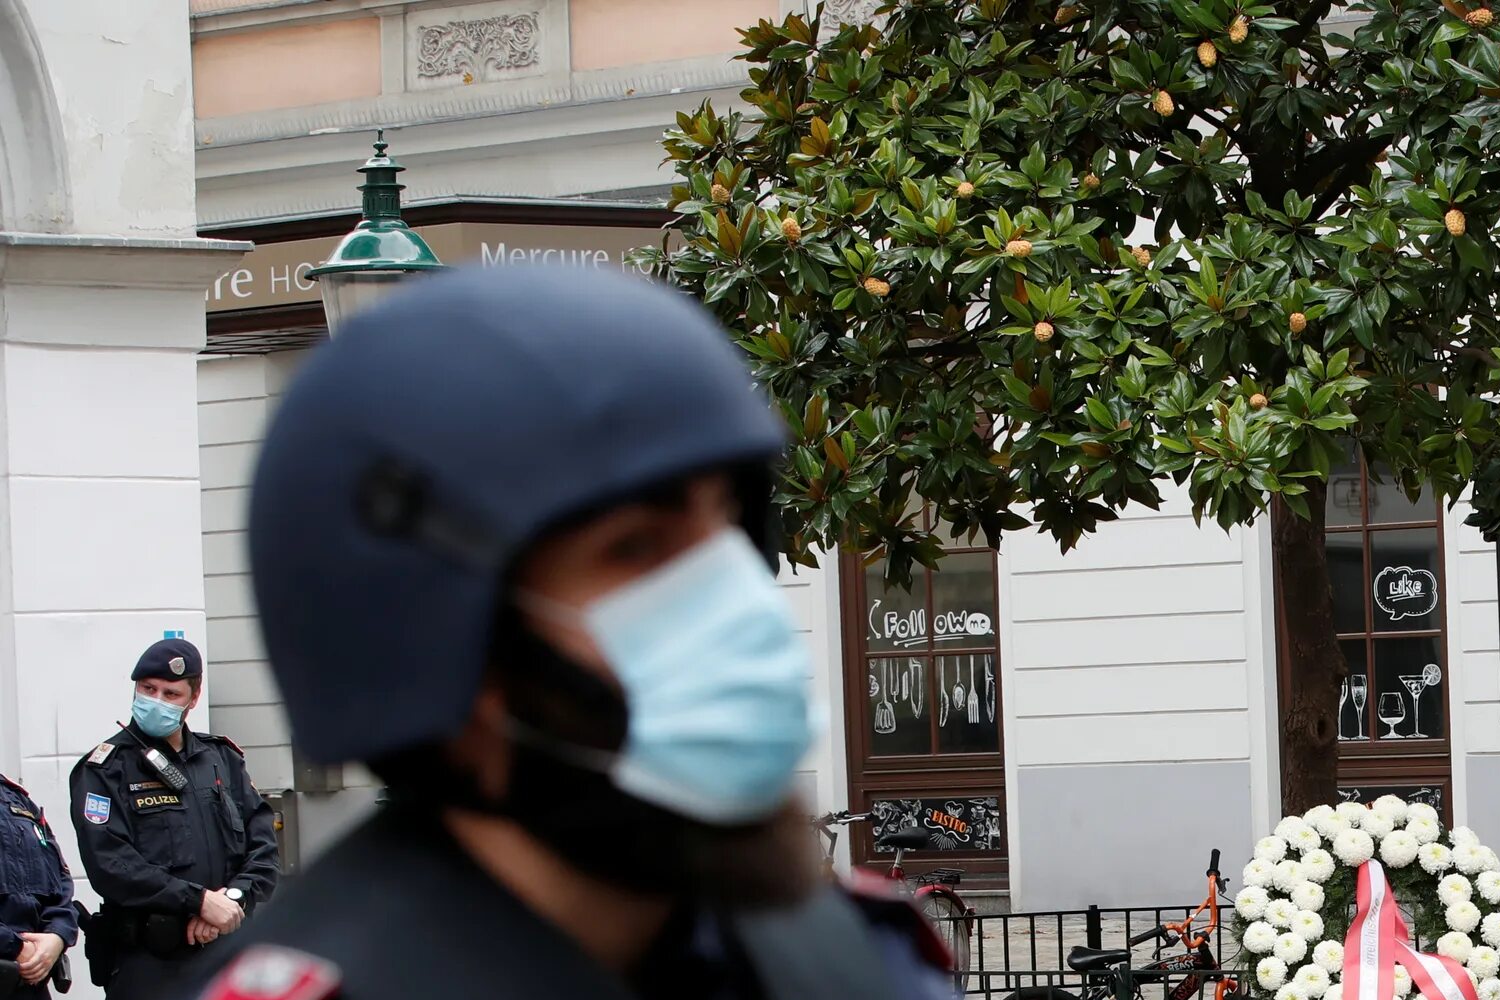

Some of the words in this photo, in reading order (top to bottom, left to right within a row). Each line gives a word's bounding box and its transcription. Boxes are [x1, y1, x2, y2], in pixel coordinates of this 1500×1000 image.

[480, 242, 610, 270] Mercure
[205, 269, 254, 300] re
[86, 798, 109, 814] BE
[136, 795, 179, 808] POLIZEI
[931, 809, 967, 833] BISTRO
